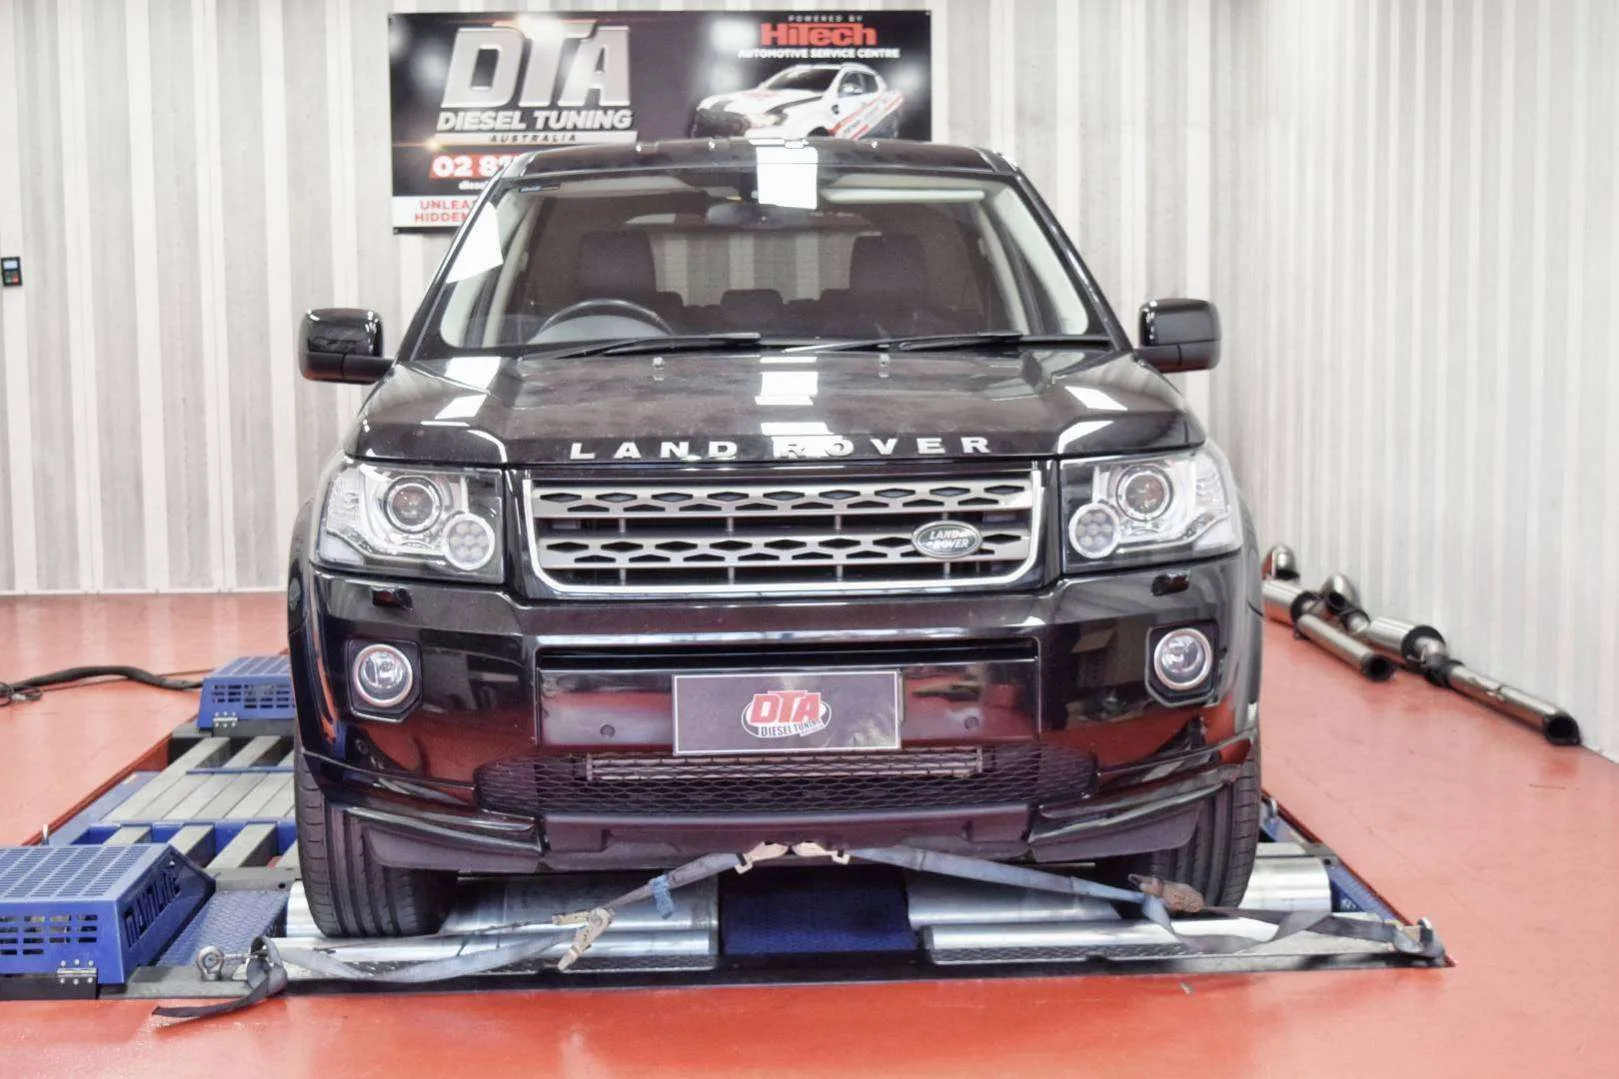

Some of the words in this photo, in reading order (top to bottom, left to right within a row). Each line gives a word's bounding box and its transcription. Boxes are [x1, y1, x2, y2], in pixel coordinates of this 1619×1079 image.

[760, 22, 878, 46] HiTech
[737, 48, 809, 59] AUTOMOTIVE
[810, 48, 855, 59] SERVICE
[857, 48, 901, 59] CENTRE
[440, 18, 631, 108] DTA
[436, 110, 527, 132] DIESEL
[532, 109, 634, 131] TUNING
[490, 133, 577, 143] AUSTRALIA
[432, 155, 474, 177] 02
[420, 200, 475, 210] UNLEA
[570, 441, 738, 460] LAND
[775, 436, 991, 458] ROVER
[929, 530, 961, 541] LAND
[931, 539, 970, 549] ROVER
[749, 690, 821, 725] DTA
[761, 724, 793, 736] DIESEL
